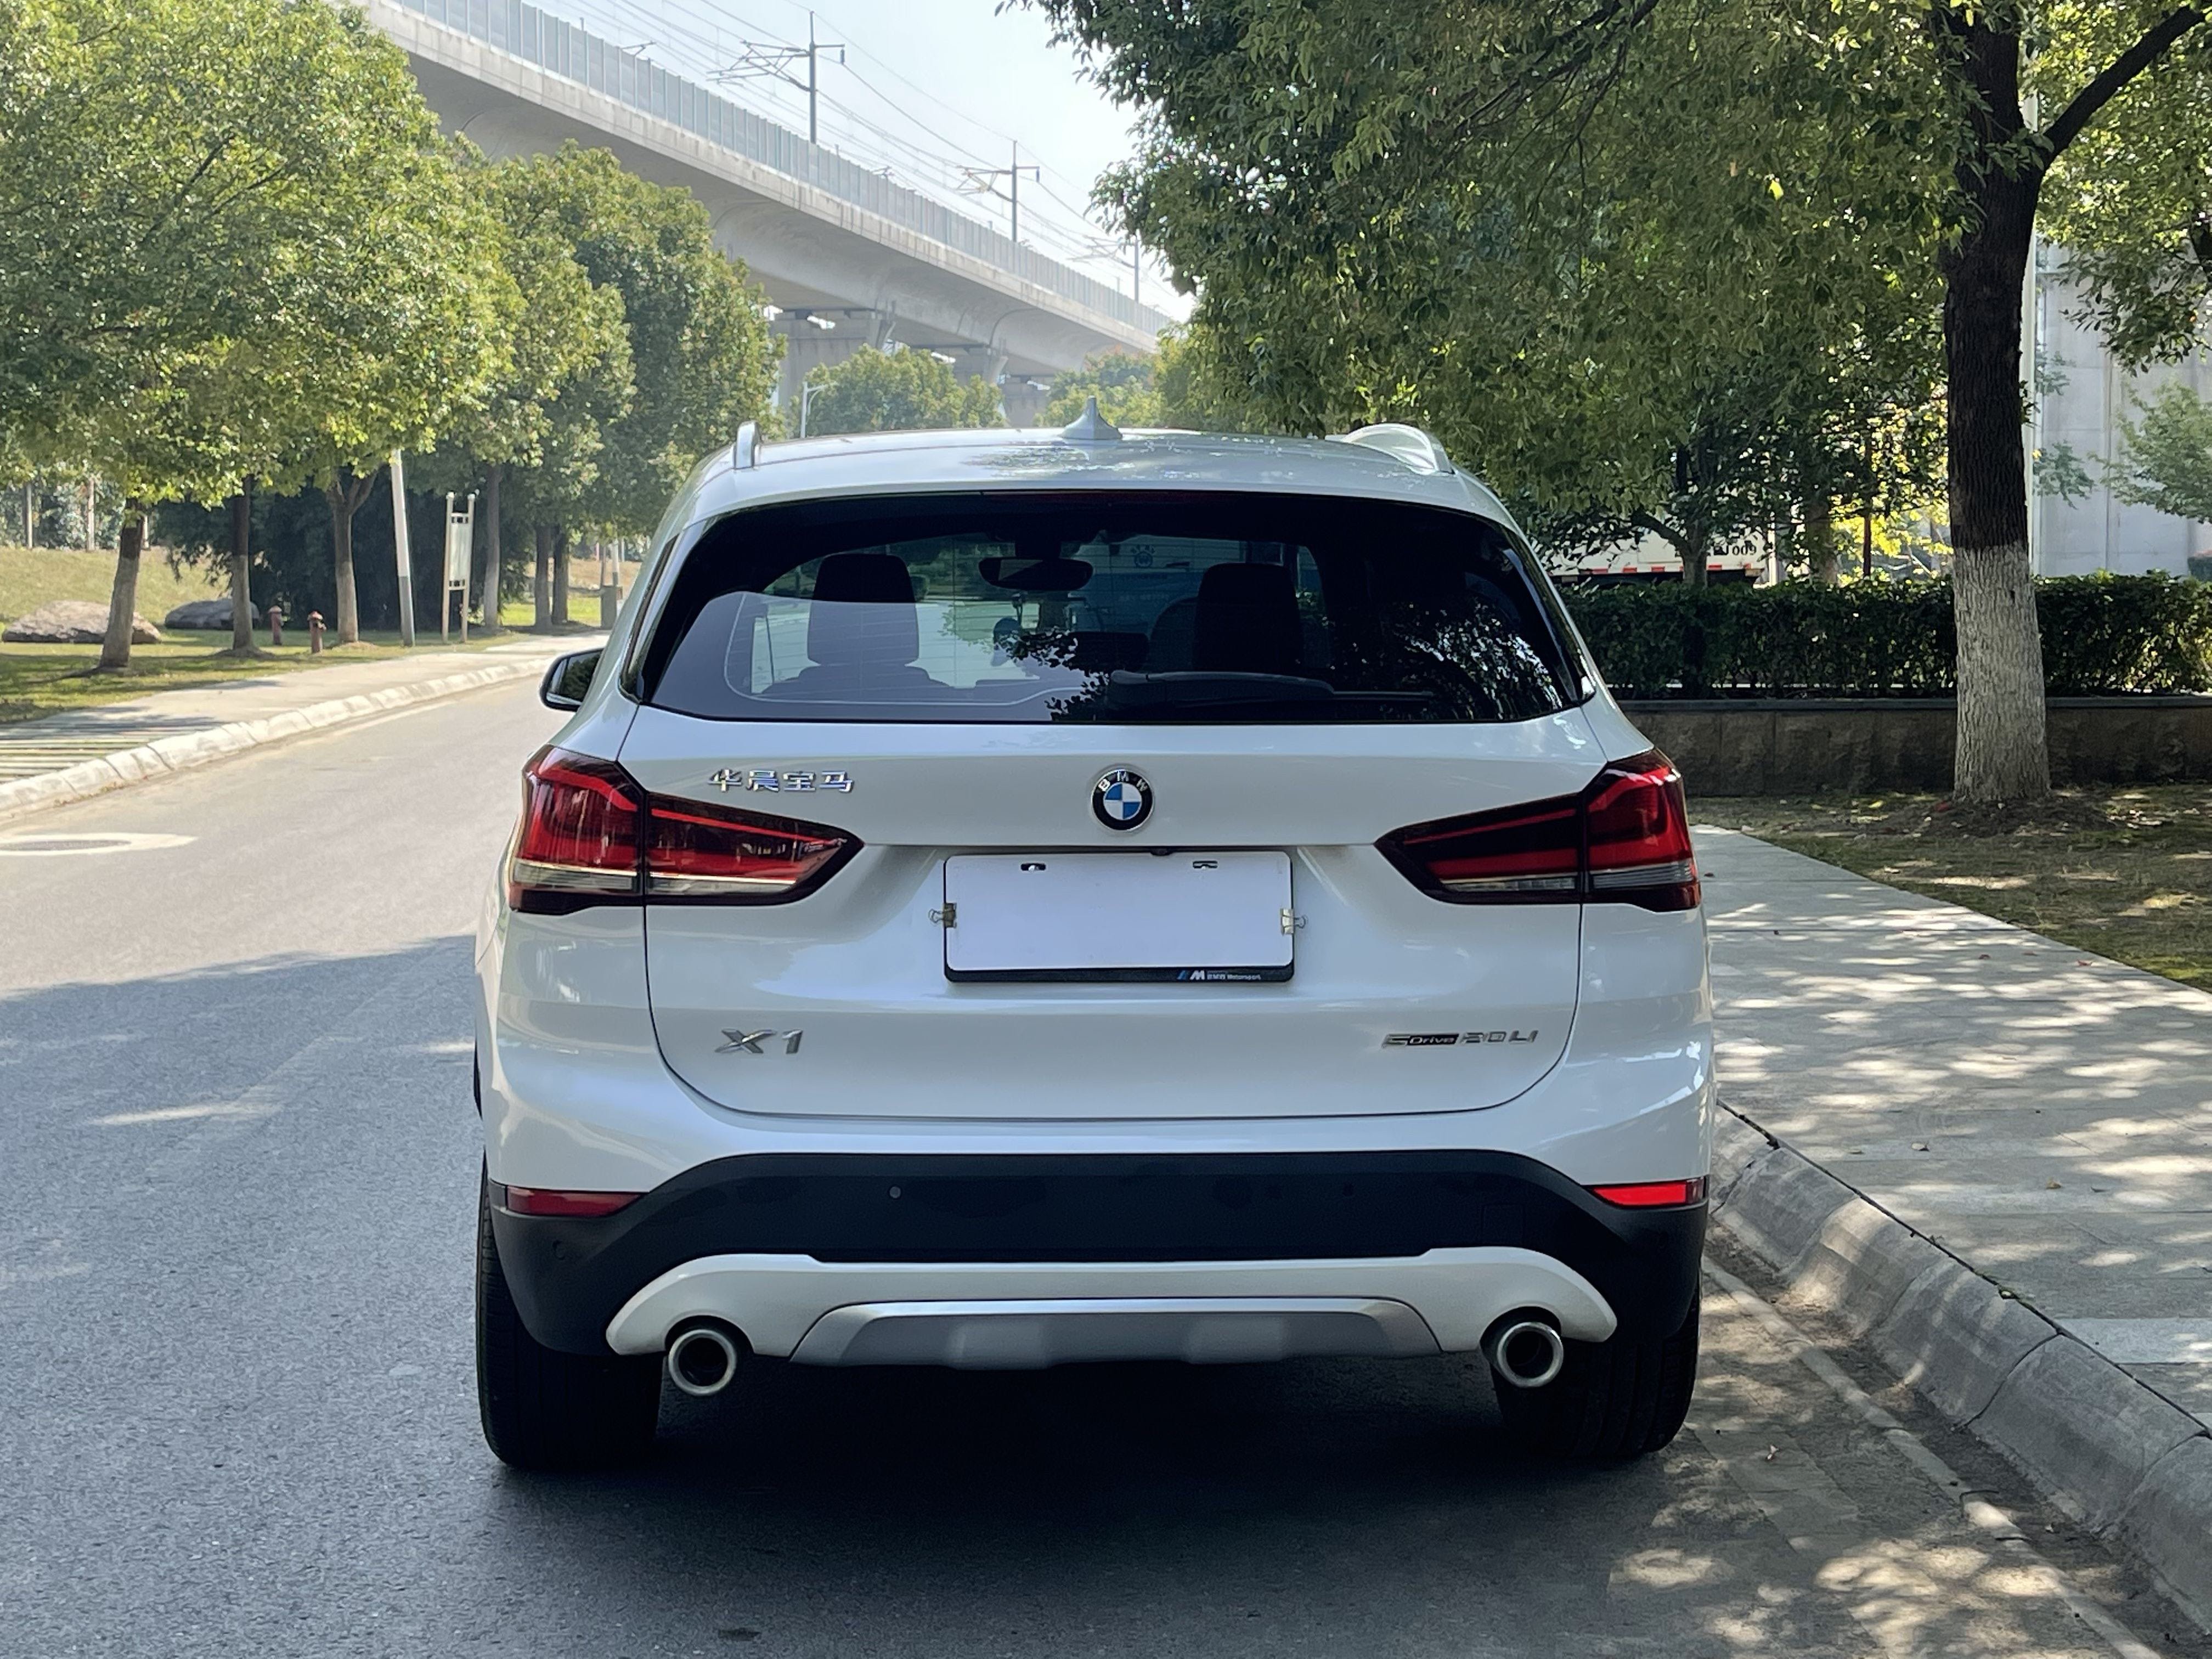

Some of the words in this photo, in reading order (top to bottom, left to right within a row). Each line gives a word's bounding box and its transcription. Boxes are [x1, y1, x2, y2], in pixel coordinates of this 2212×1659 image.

[707, 768, 855, 793] 华晨宝马
[1098, 770, 1148, 792] BMW
[714, 1028, 803, 1054] X1
